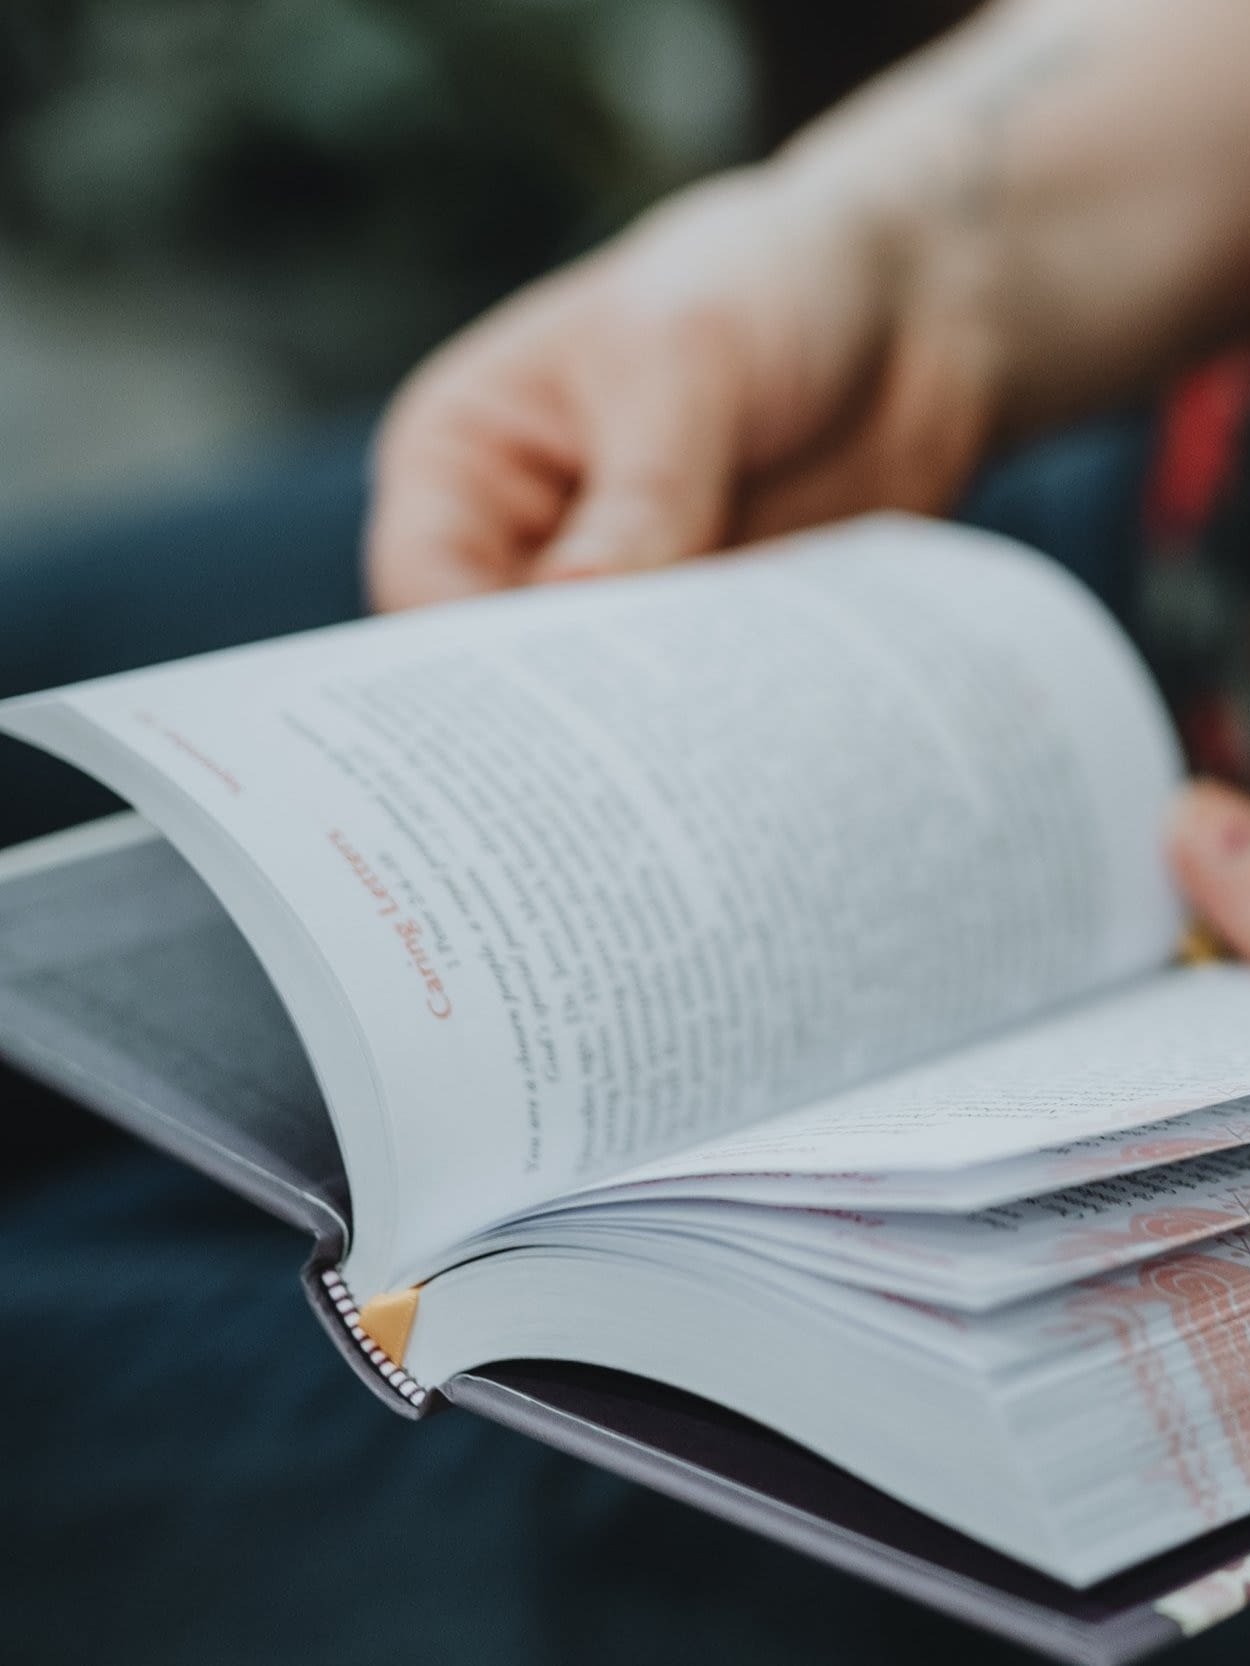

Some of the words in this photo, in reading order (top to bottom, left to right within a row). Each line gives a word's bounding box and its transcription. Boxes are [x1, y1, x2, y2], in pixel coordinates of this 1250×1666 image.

[328, 826, 399, 917] Letters
[394, 919, 453, 1020] Caring
[527, 1099, 542, 1130] are
